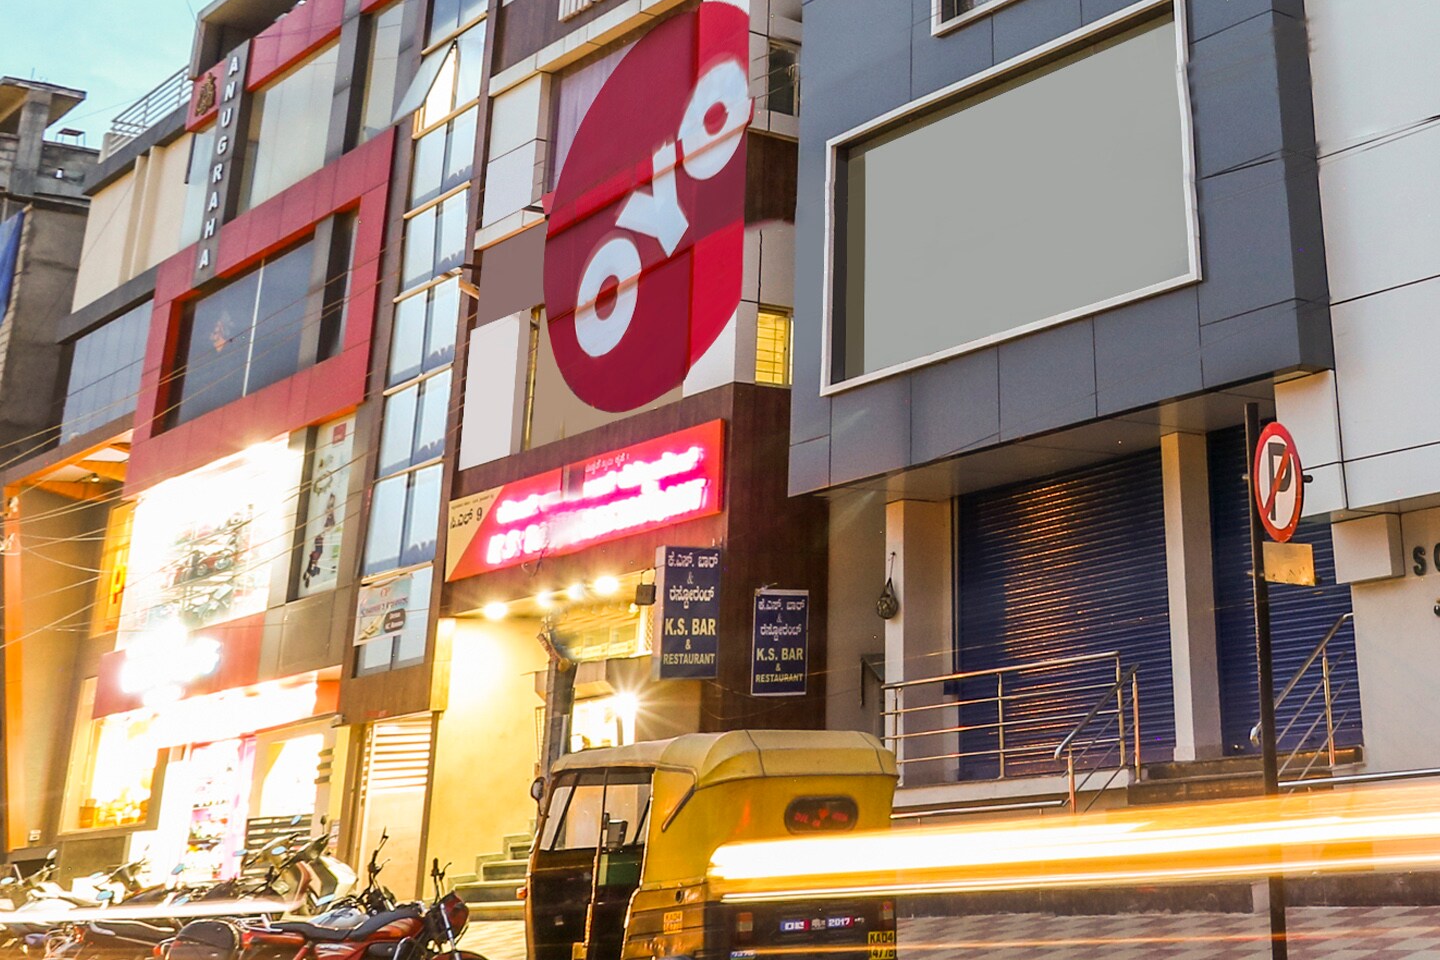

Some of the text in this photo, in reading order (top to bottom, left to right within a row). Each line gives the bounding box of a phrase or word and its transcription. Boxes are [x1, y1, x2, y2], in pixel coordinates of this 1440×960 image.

[199, 56, 239, 269] ANUGRAHA
[1412, 546, 1427, 576] S
[665, 618, 716, 635] K.S. BAR
[685, 638, 692, 650] &
[663, 653, 715, 665] RESTAURANT
[756, 648, 803, 661] K.S. BAR
[755, 673, 803, 683] RESTAURANT
[828, 917, 850, 927] 2017
[870, 932, 893, 943] KA04
